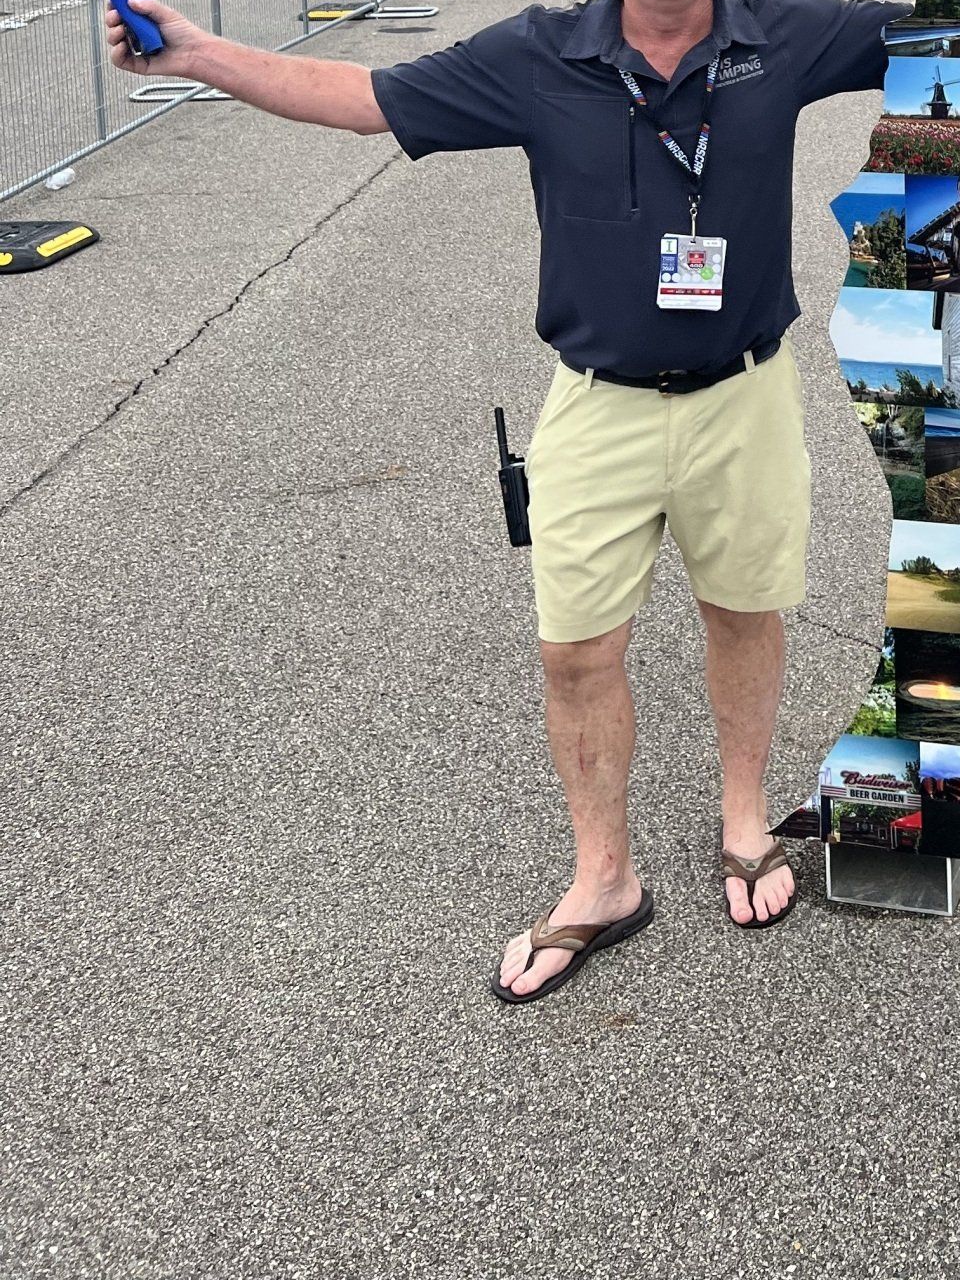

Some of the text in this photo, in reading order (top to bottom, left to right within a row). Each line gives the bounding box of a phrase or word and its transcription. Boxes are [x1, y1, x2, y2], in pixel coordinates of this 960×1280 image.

[693, 135, 708, 176] NASCAR
[840, 770, 913, 790] Budweiser
[850, 789, 905, 804] BEER GARDEN
